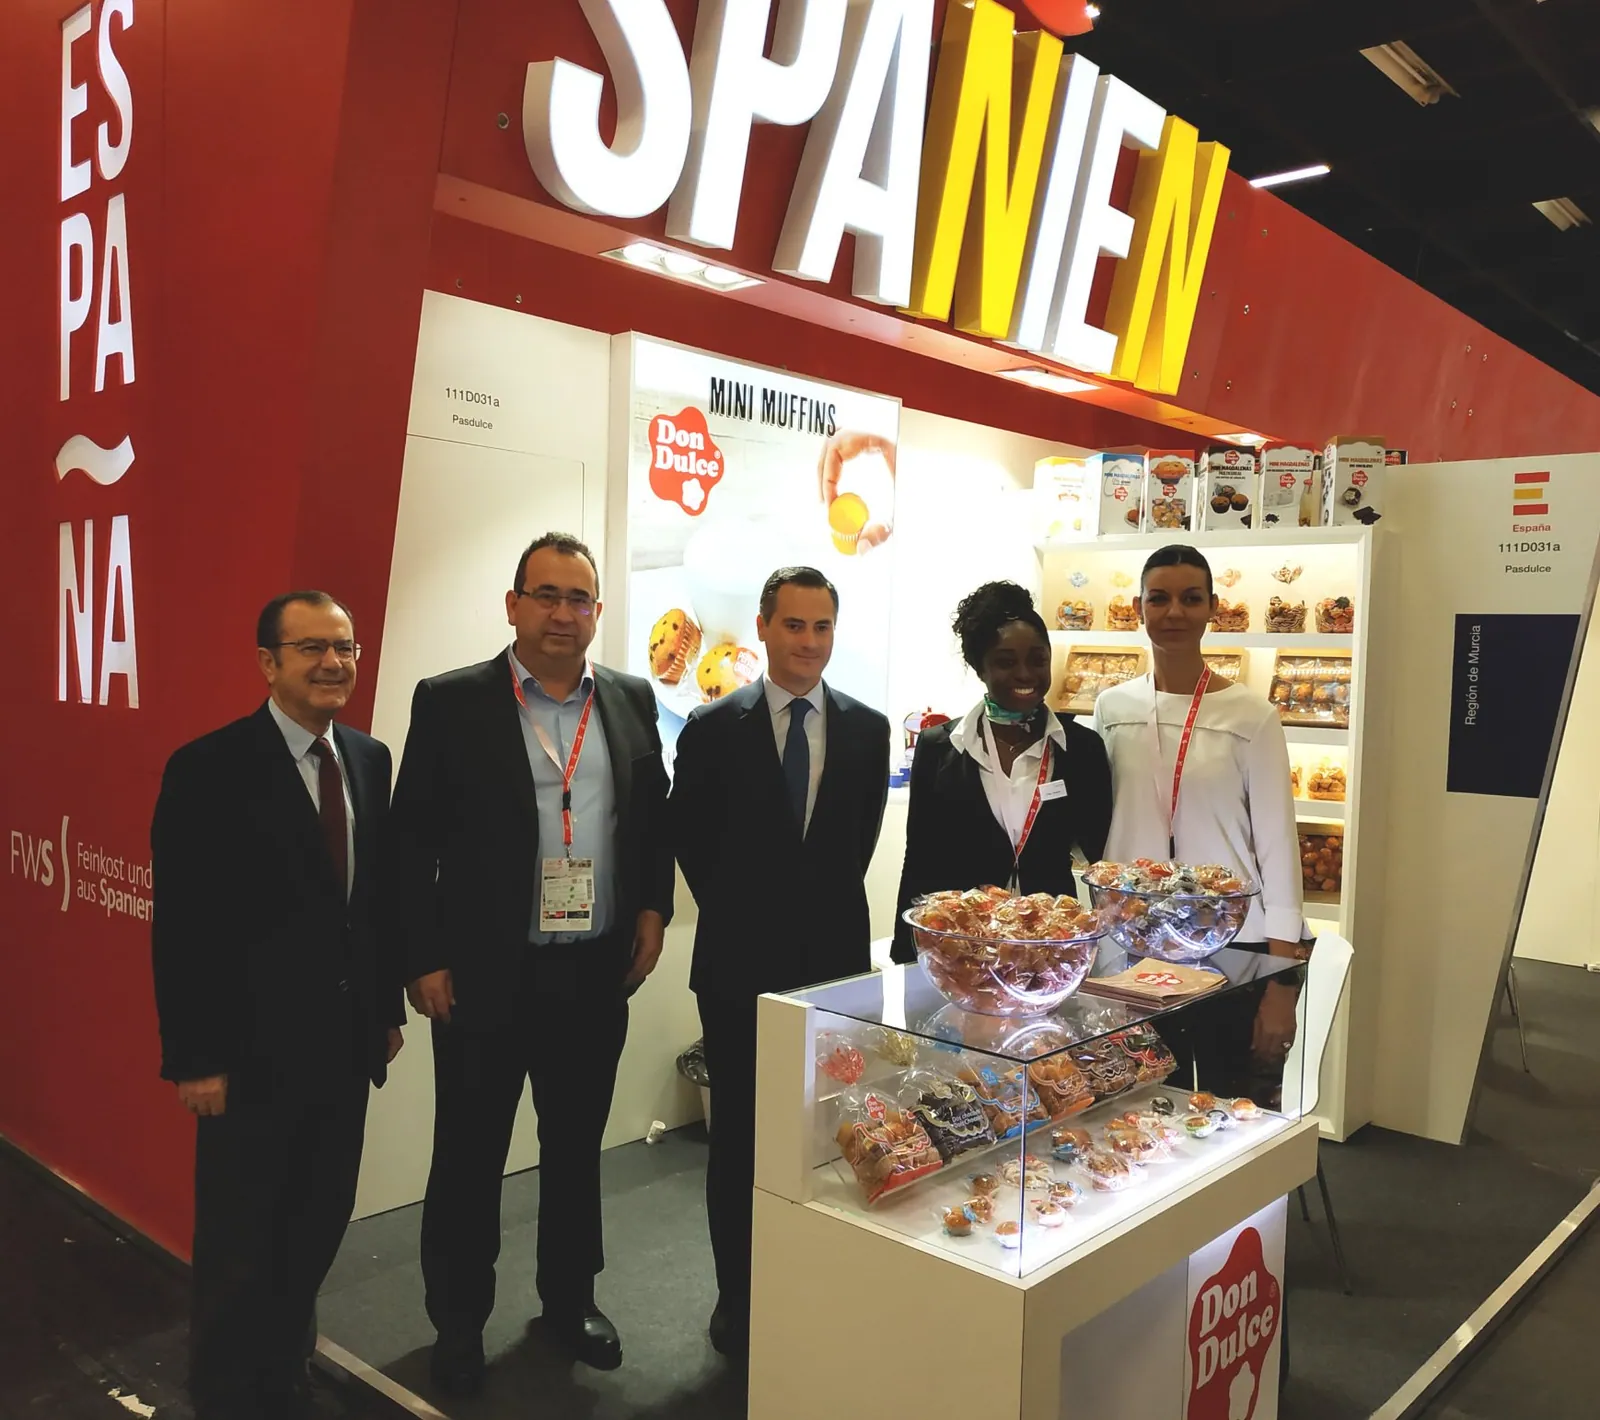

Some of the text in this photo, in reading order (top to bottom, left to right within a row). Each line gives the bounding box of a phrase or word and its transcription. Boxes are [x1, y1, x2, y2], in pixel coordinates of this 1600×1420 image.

[445, 387, 500, 408] 111D031a
[709, 376, 837, 437] MINI MUFFINS
[452, 414, 493, 430] Pasdulce
[656, 418, 704, 450] Don
[654, 444, 719, 478] Dulce
[1498, 541, 1561, 553] 111D031a
[1512, 523, 1551, 533] España
[1505, 564, 1552, 573] Pasdulce
[1465, 624, 1481, 725] Región de Murcia
[11, 830, 55, 887] FWS
[77, 842, 153, 889] Feinkost und
[76, 878, 154, 922] aus Spanien
[1199, 1270, 1258, 1338] Don
[1196, 1304, 1274, 1390] Dulce
